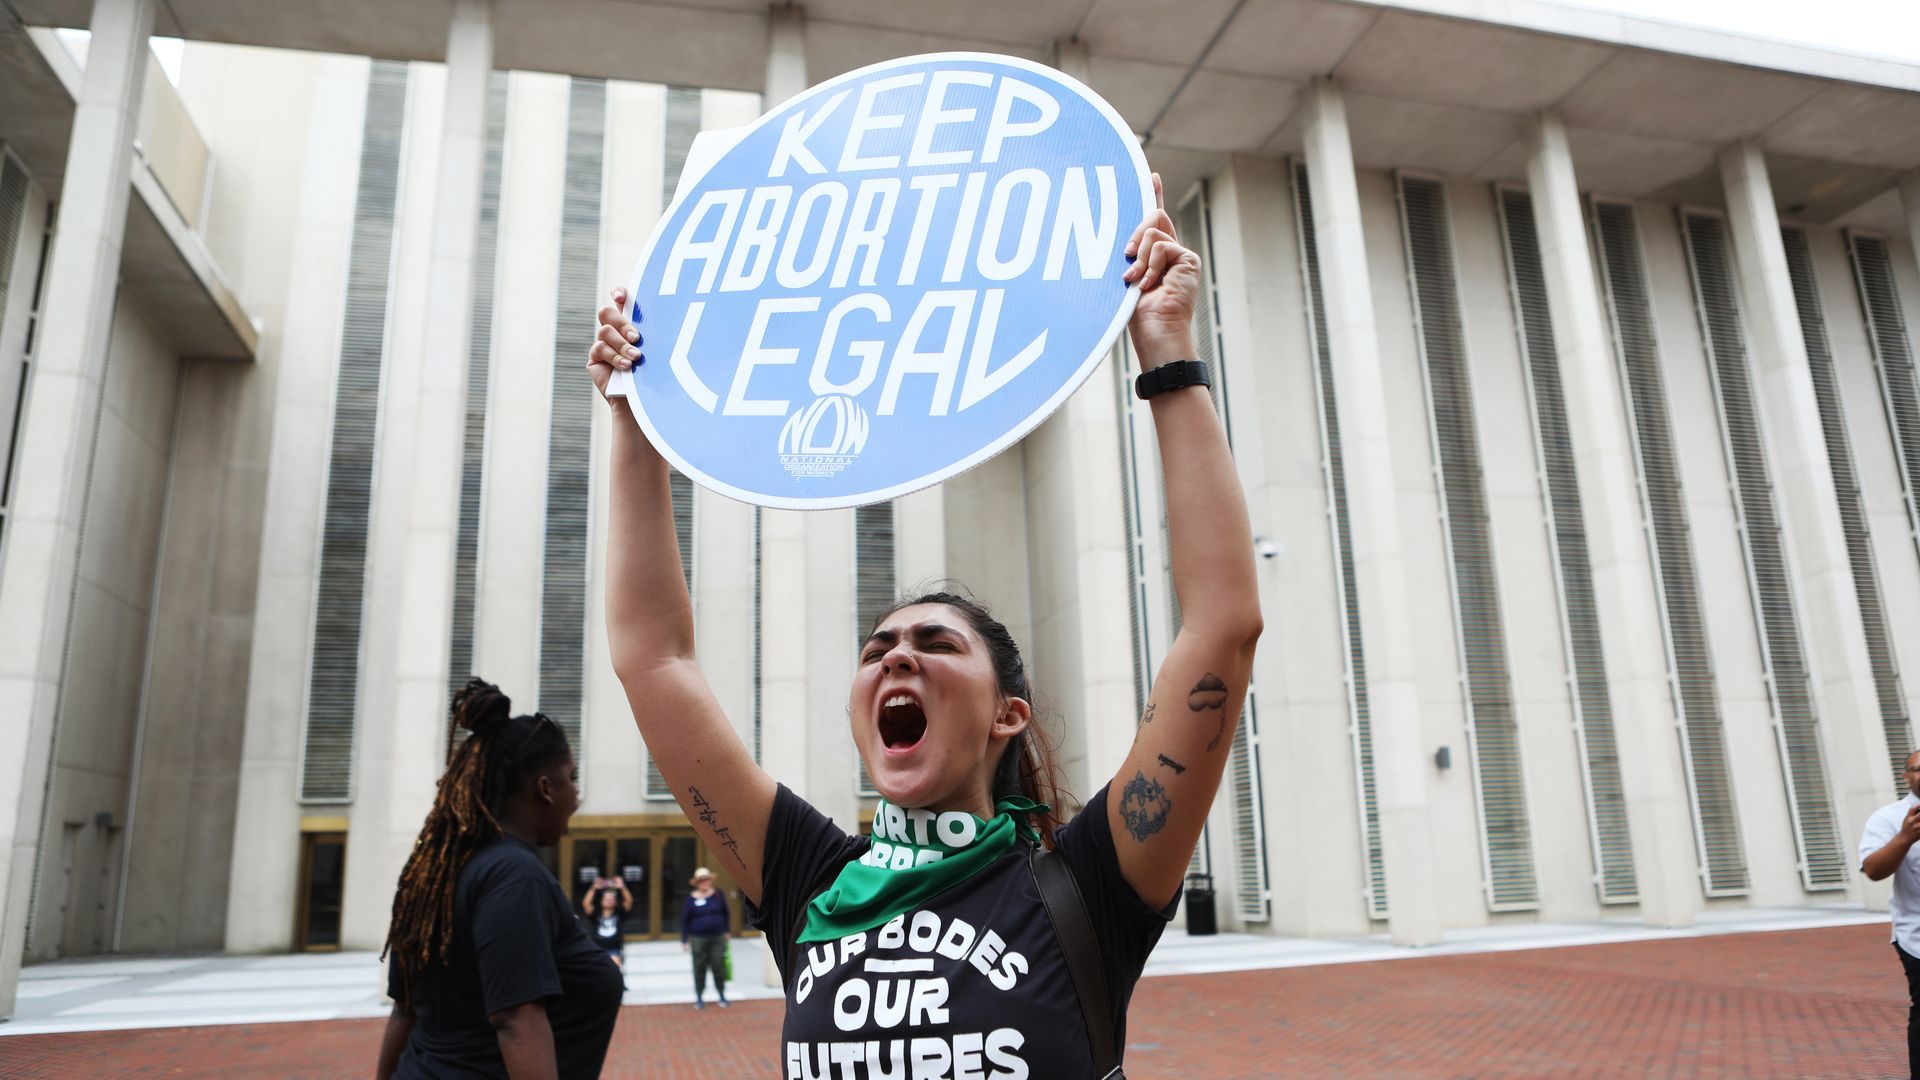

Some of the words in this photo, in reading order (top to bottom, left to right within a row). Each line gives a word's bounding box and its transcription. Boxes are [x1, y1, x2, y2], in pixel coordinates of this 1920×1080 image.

[768, 70, 1060, 177] KEEP
[659, 165, 1119, 296] ABORTION
[669, 289, 1048, 416] LEGAL
[778, 395, 869, 454] NOW
[780, 456, 853, 464] NATIONAL
[796, 932, 867, 1004] OUR
[878, 910, 1029, 991] BODES
[833, 977, 950, 1031] OUR
[787, 1027, 1030, 1080] FUTURES
